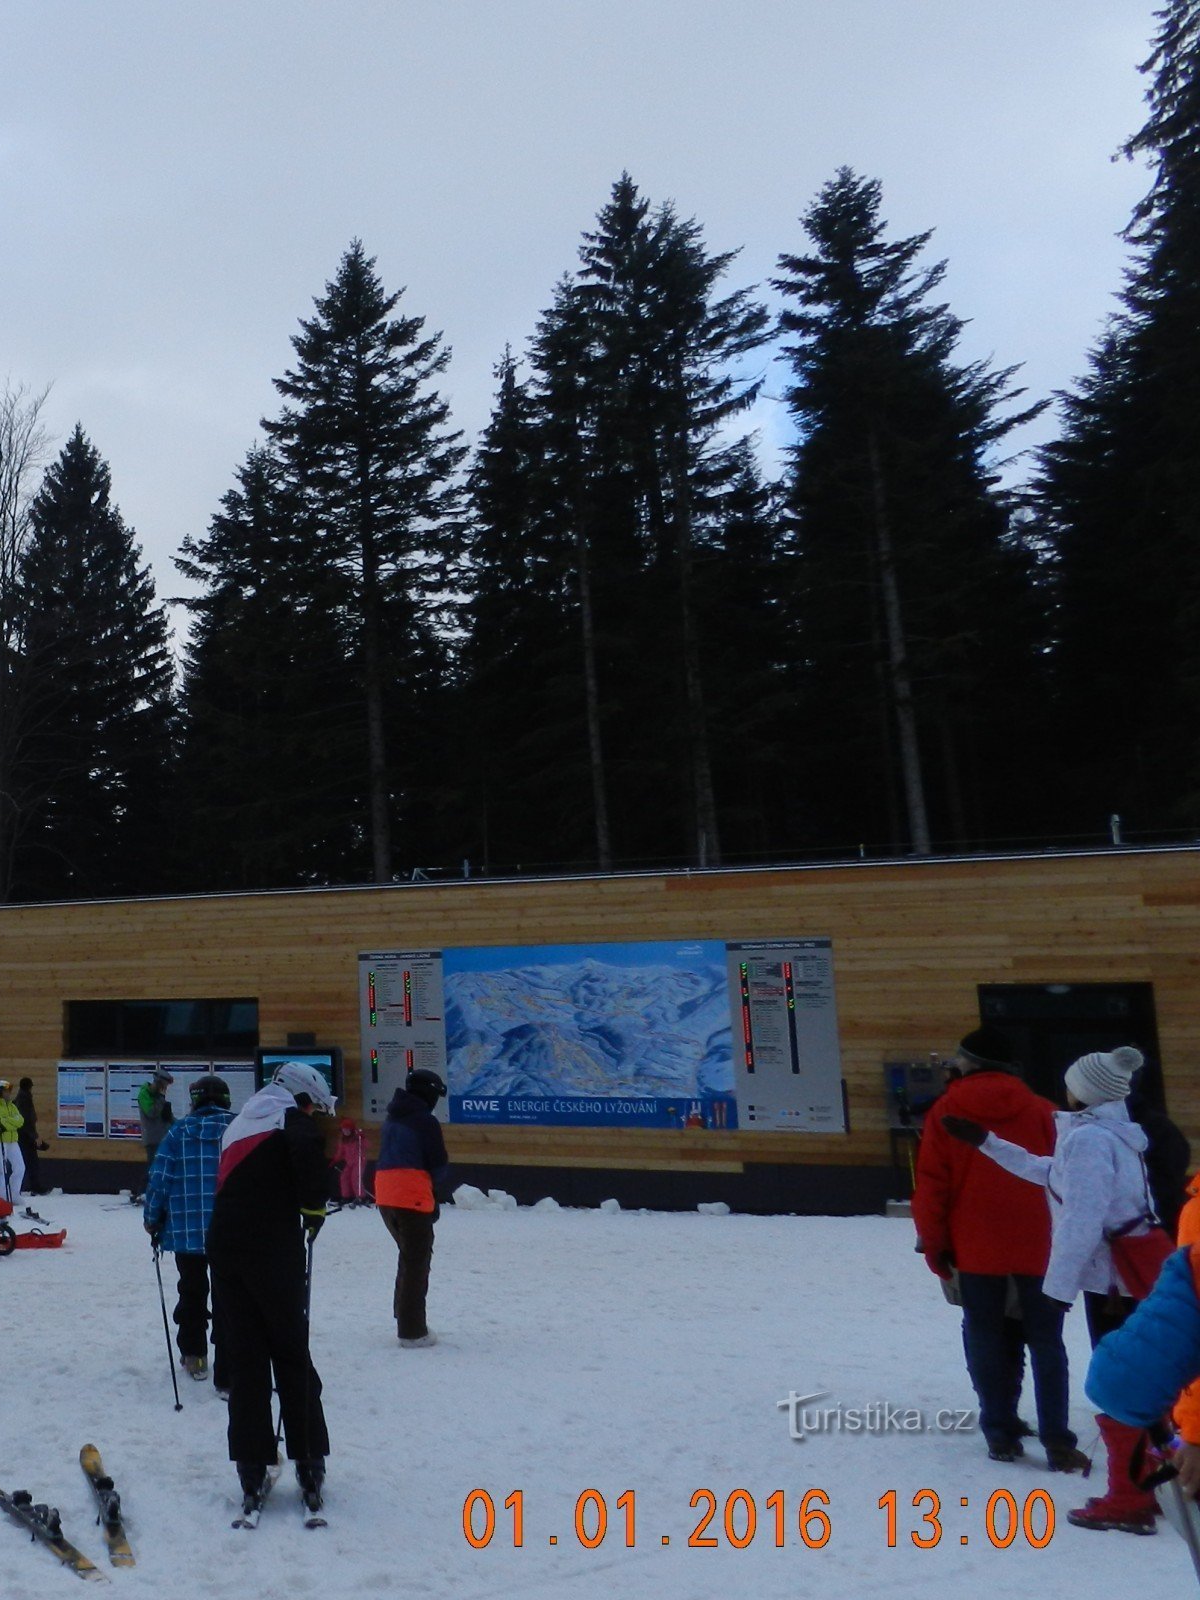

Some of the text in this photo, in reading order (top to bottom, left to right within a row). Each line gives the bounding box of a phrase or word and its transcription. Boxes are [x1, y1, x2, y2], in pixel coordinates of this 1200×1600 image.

[462, 1100, 500, 1111] RWE
[507, 1099, 657, 1114] ENERGIE ČESKÉHO LYŽOVÁNÍ
